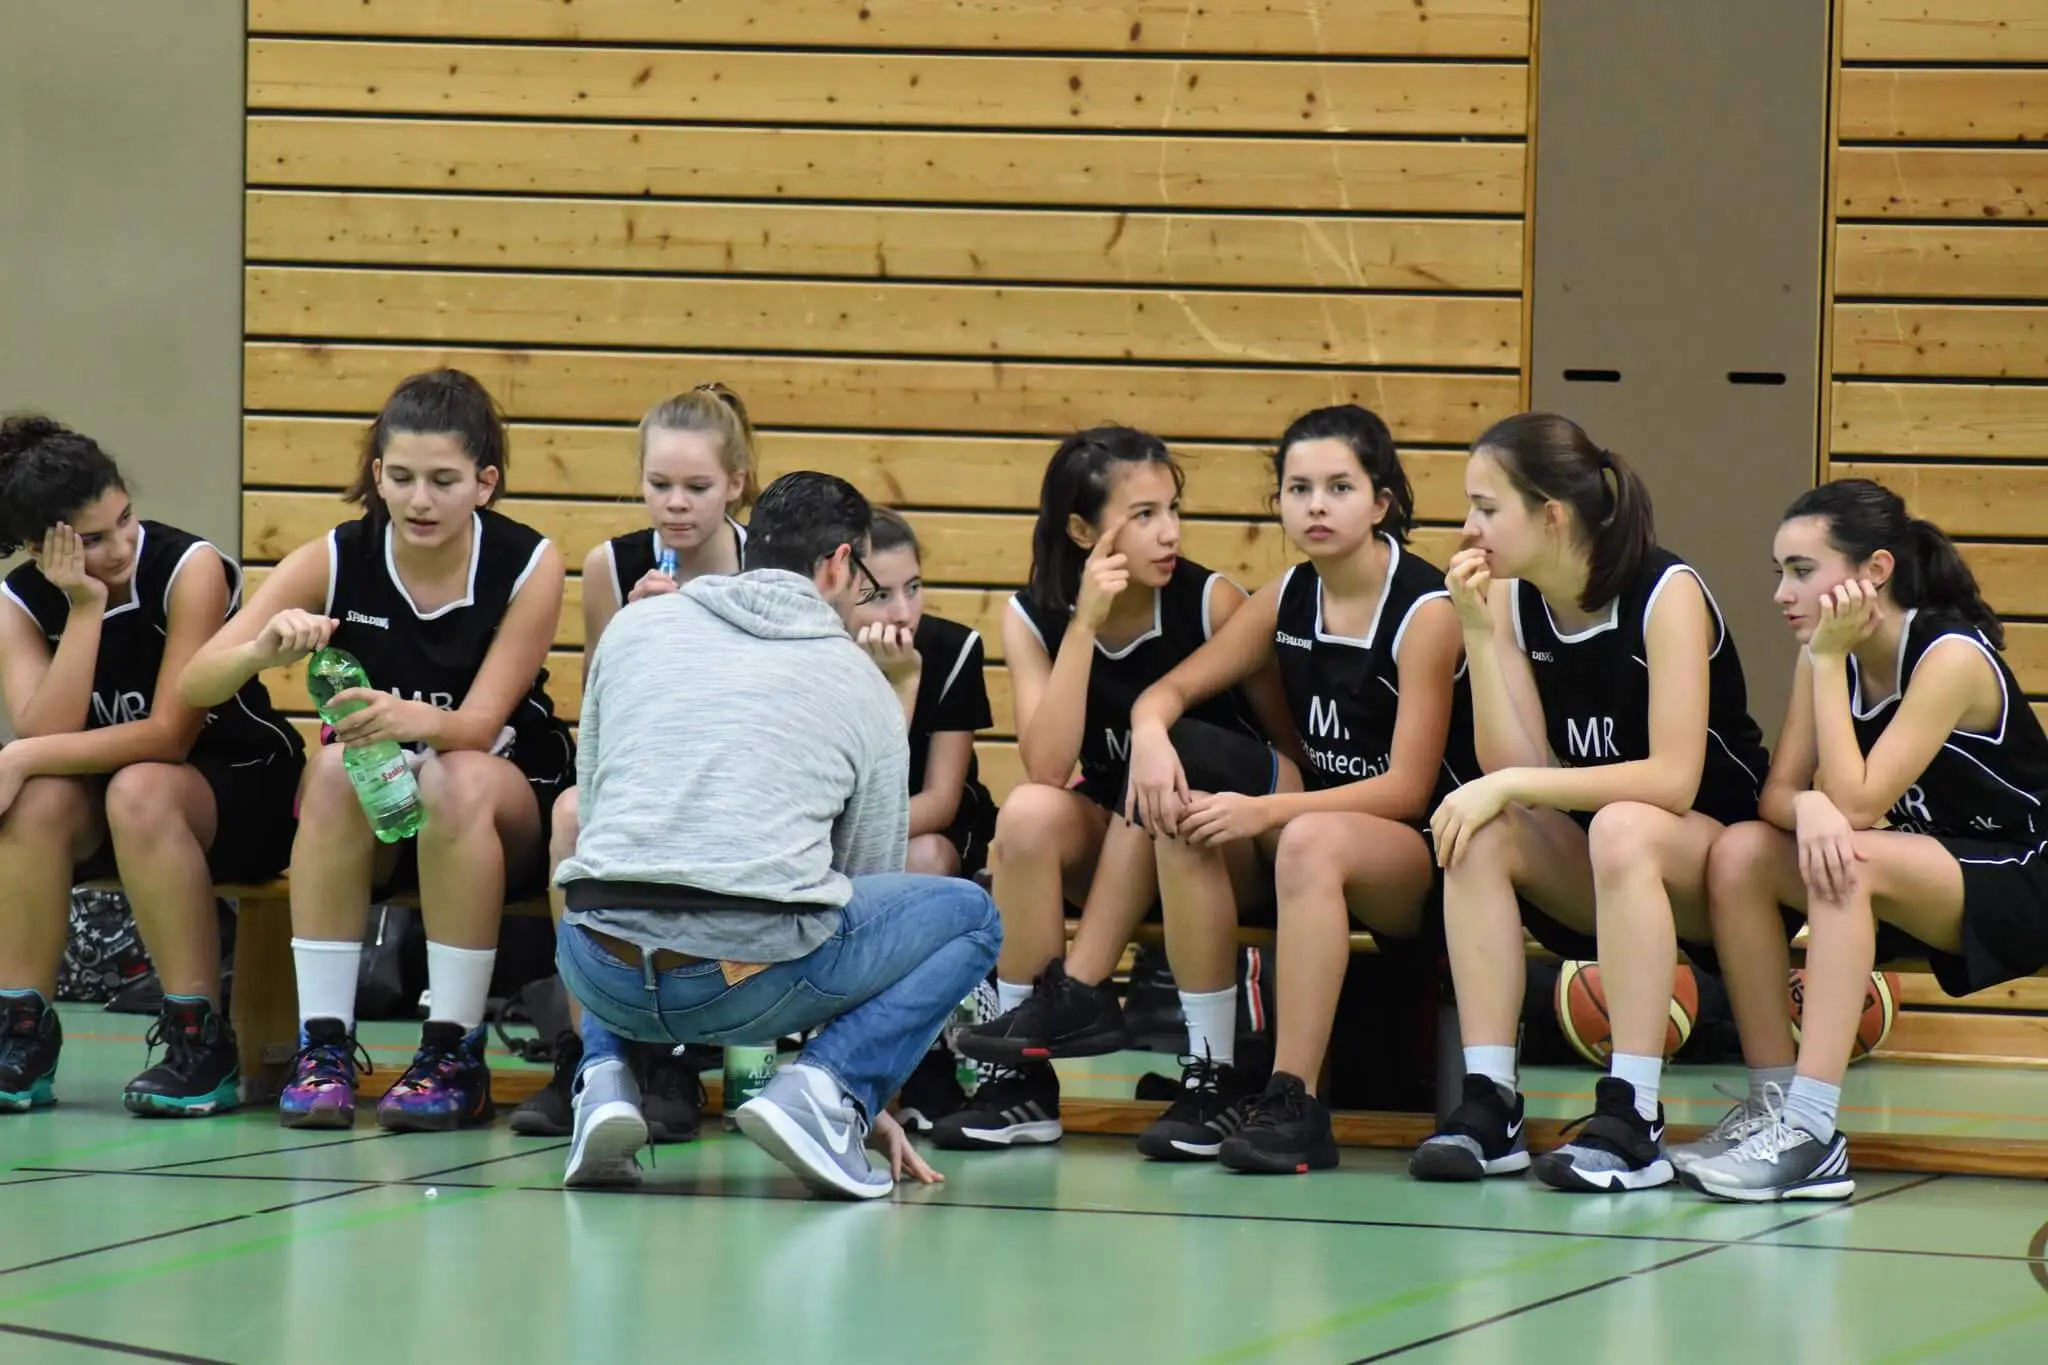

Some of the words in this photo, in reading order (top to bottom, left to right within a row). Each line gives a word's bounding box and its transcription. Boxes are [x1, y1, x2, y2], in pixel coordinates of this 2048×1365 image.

[1275, 630, 1313, 651] SPALDIN
[1308, 695, 1350, 740] M
[1567, 716, 1621, 757] MR
[1891, 783, 1933, 822] R
